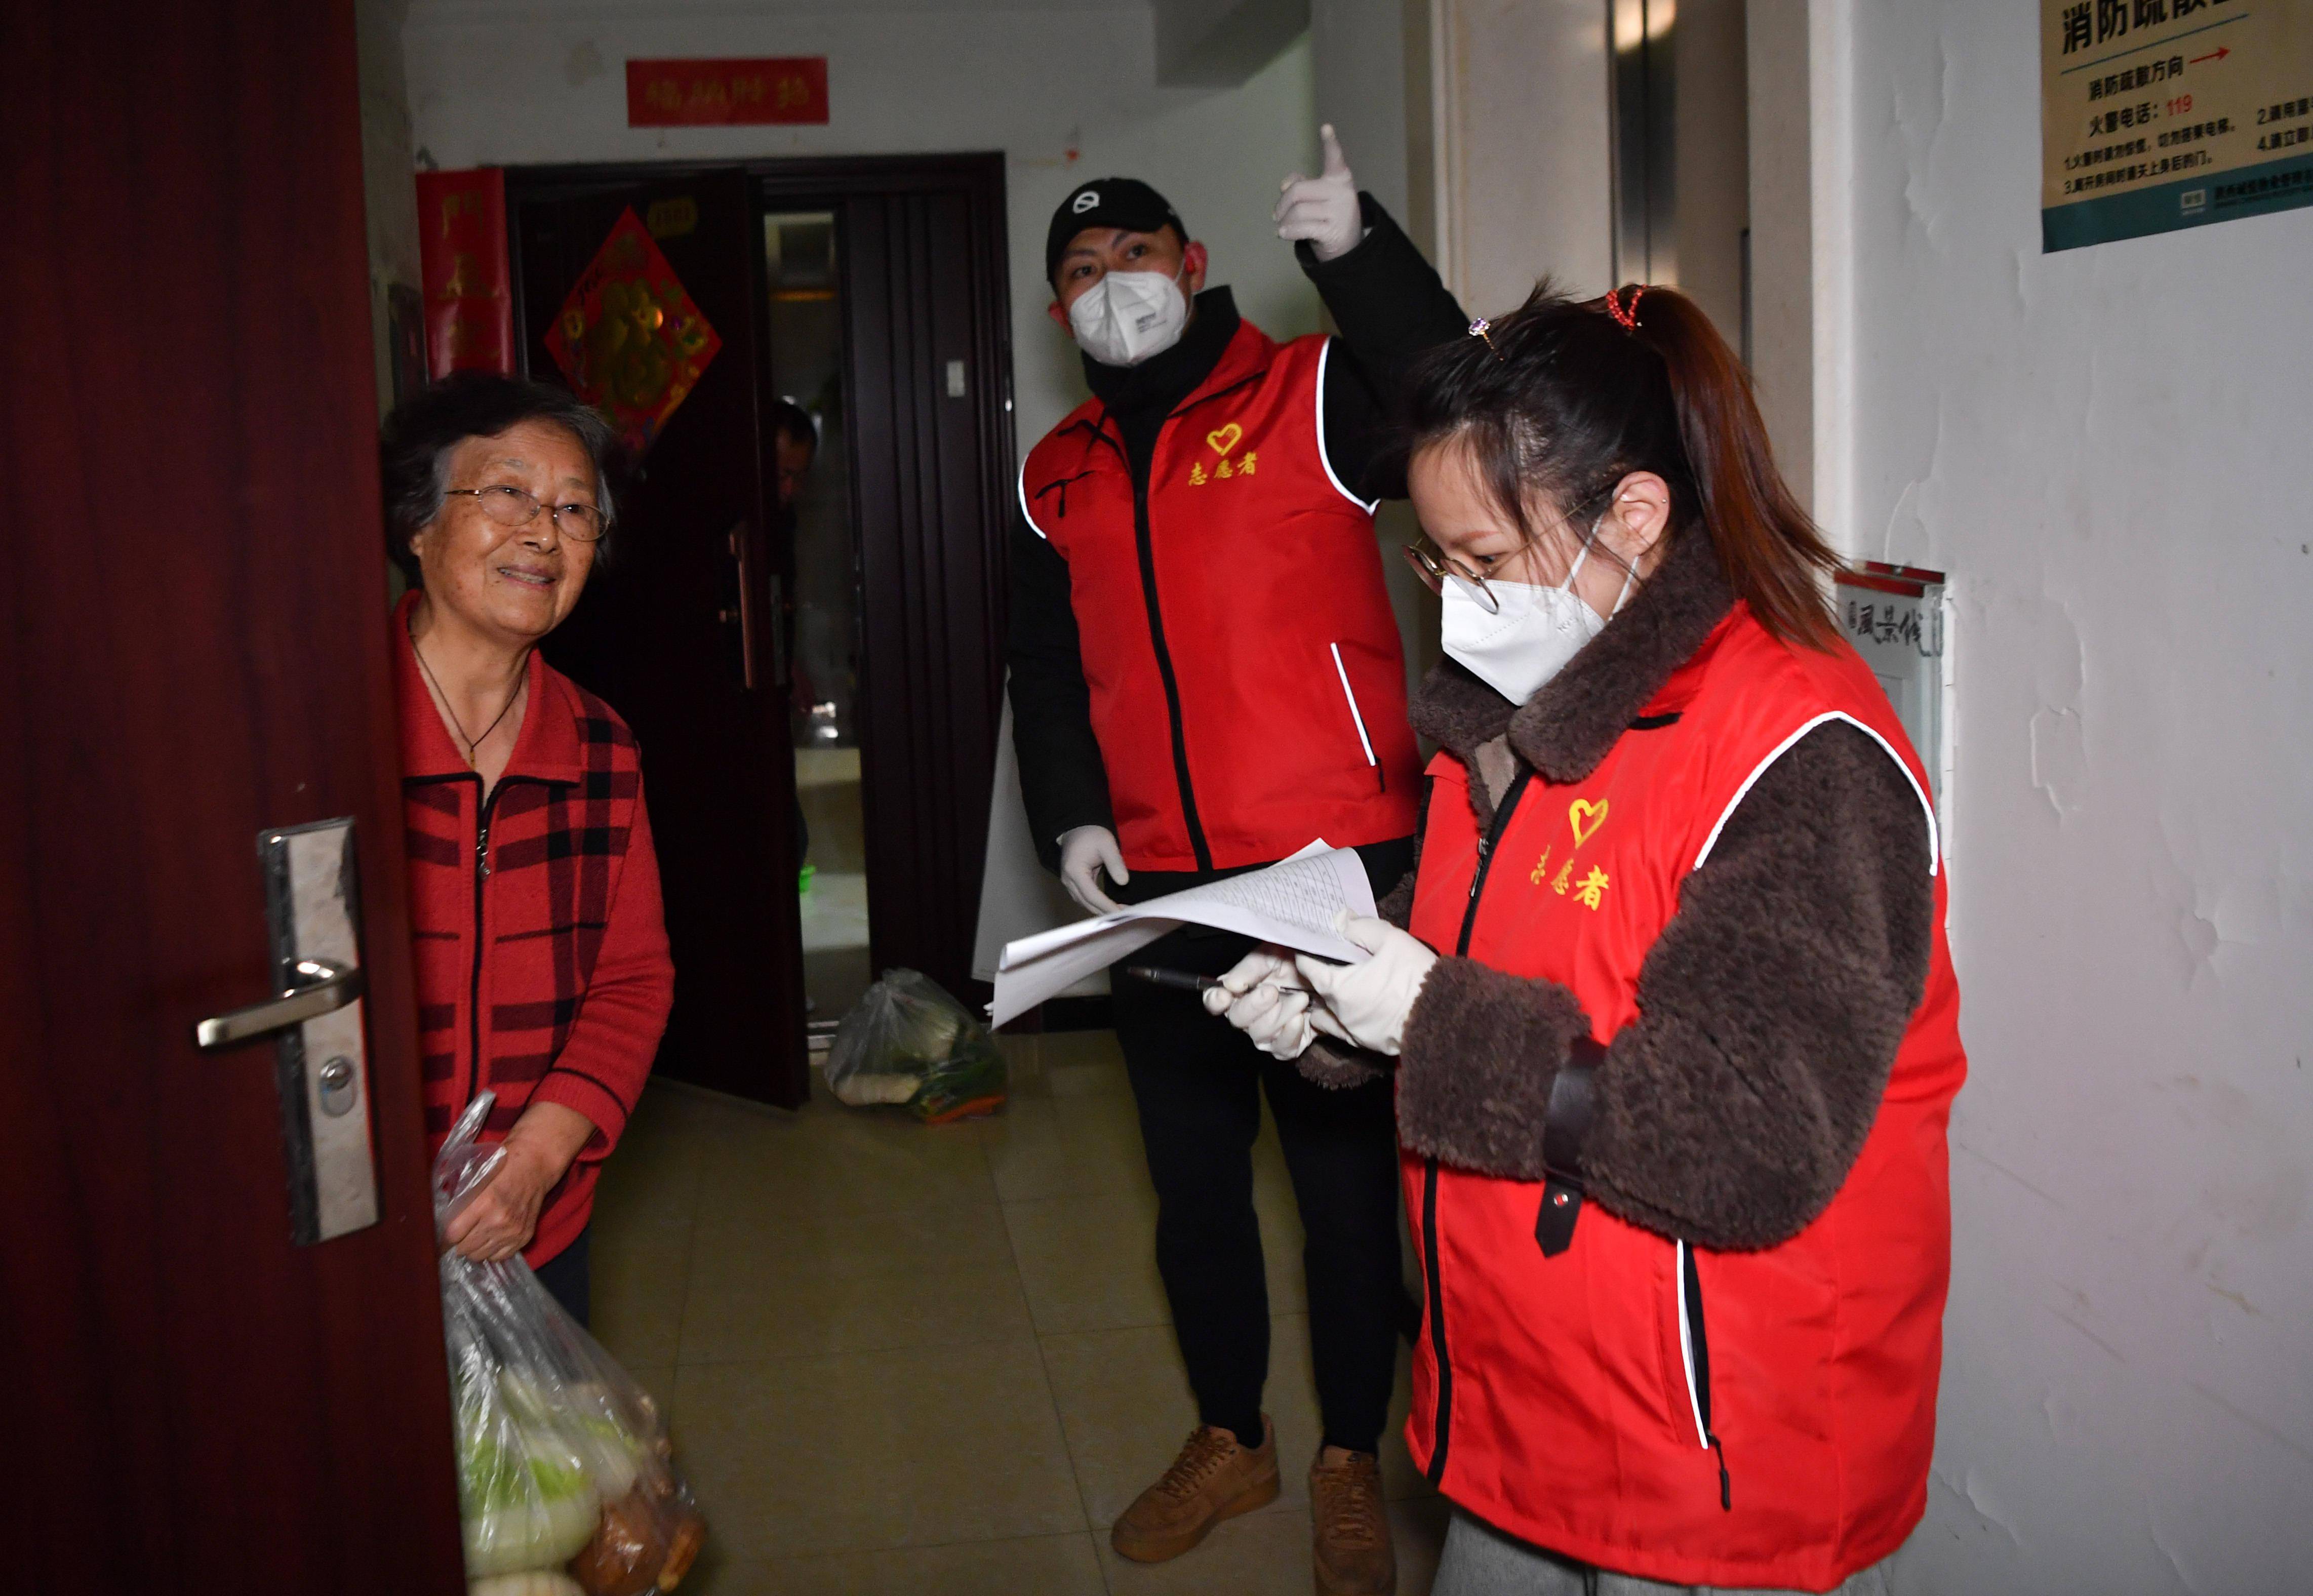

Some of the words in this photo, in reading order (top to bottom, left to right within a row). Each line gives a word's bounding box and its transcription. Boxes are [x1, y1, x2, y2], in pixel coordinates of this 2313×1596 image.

[2088, 55, 2184, 101] 消防疏散方向
[1188, 451, 1257, 487] 志愿者
